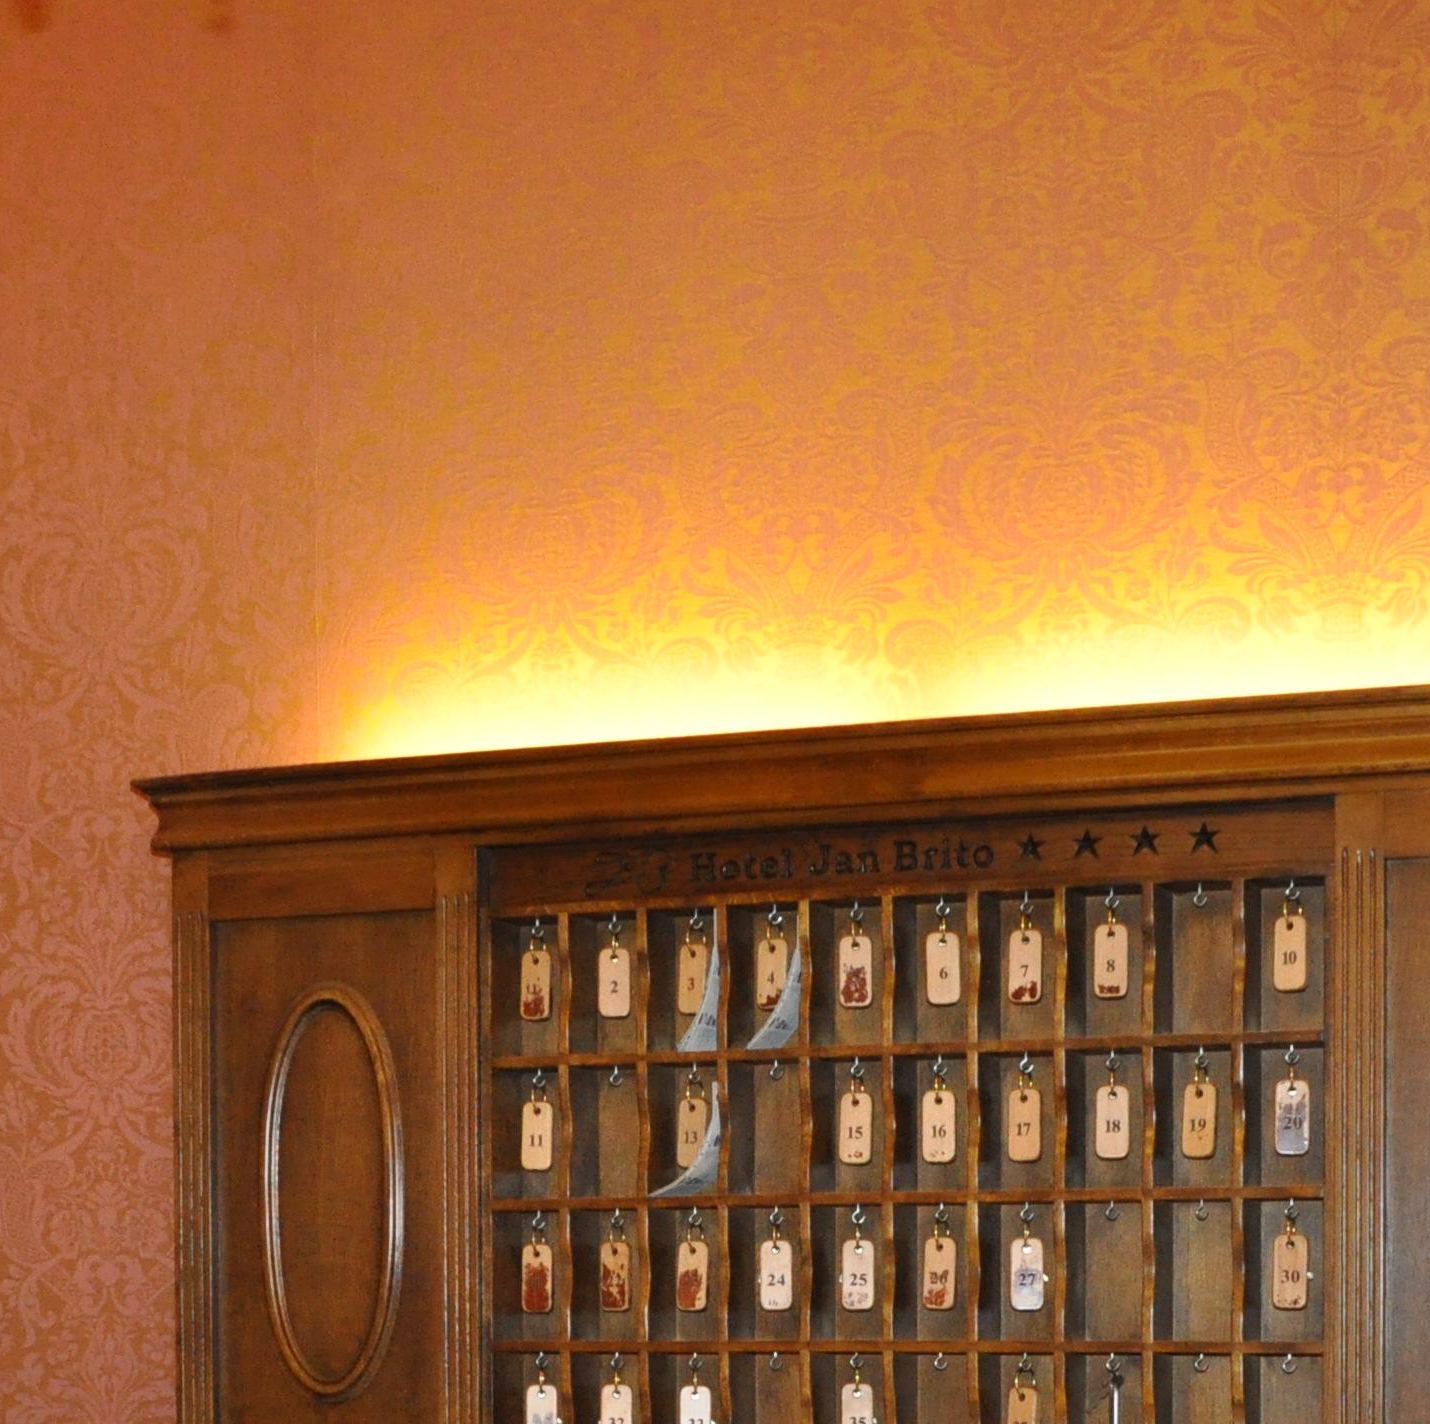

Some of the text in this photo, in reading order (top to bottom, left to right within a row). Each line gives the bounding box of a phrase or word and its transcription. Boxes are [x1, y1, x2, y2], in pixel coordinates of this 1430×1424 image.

[689, 848, 792, 883] Hotel
[809, 843, 879, 876] Jan
[892, 838, 995, 872] Brito
[1282, 950, 1297, 965] 10
[1020, 964, 1028, 978] 7
[1106, 958, 1115, 973] 8
[939, 966, 948, 981] 6
[609, 980, 619, 994] 2
[687, 977, 695, 991] 3
[1016, 1122, 1031, 1136] 17
[1105, 1119, 1121, 1133] 18
[1189, 1118, 1206, 1133] 19
[1283, 1116, 1302, 1130] 20
[683, 1131, 697, 1144] 13
[847, 1126, 863, 1140] 15
[931, 1124, 946, 1139] 16
[528, 1134, 543, 1147] 11
[767, 1273, 785, 1287] 24
[849, 1273, 867, 1286] 25
[1018, 1272, 1036, 1287] 27
[1280, 1269, 1300, 1284] 30
